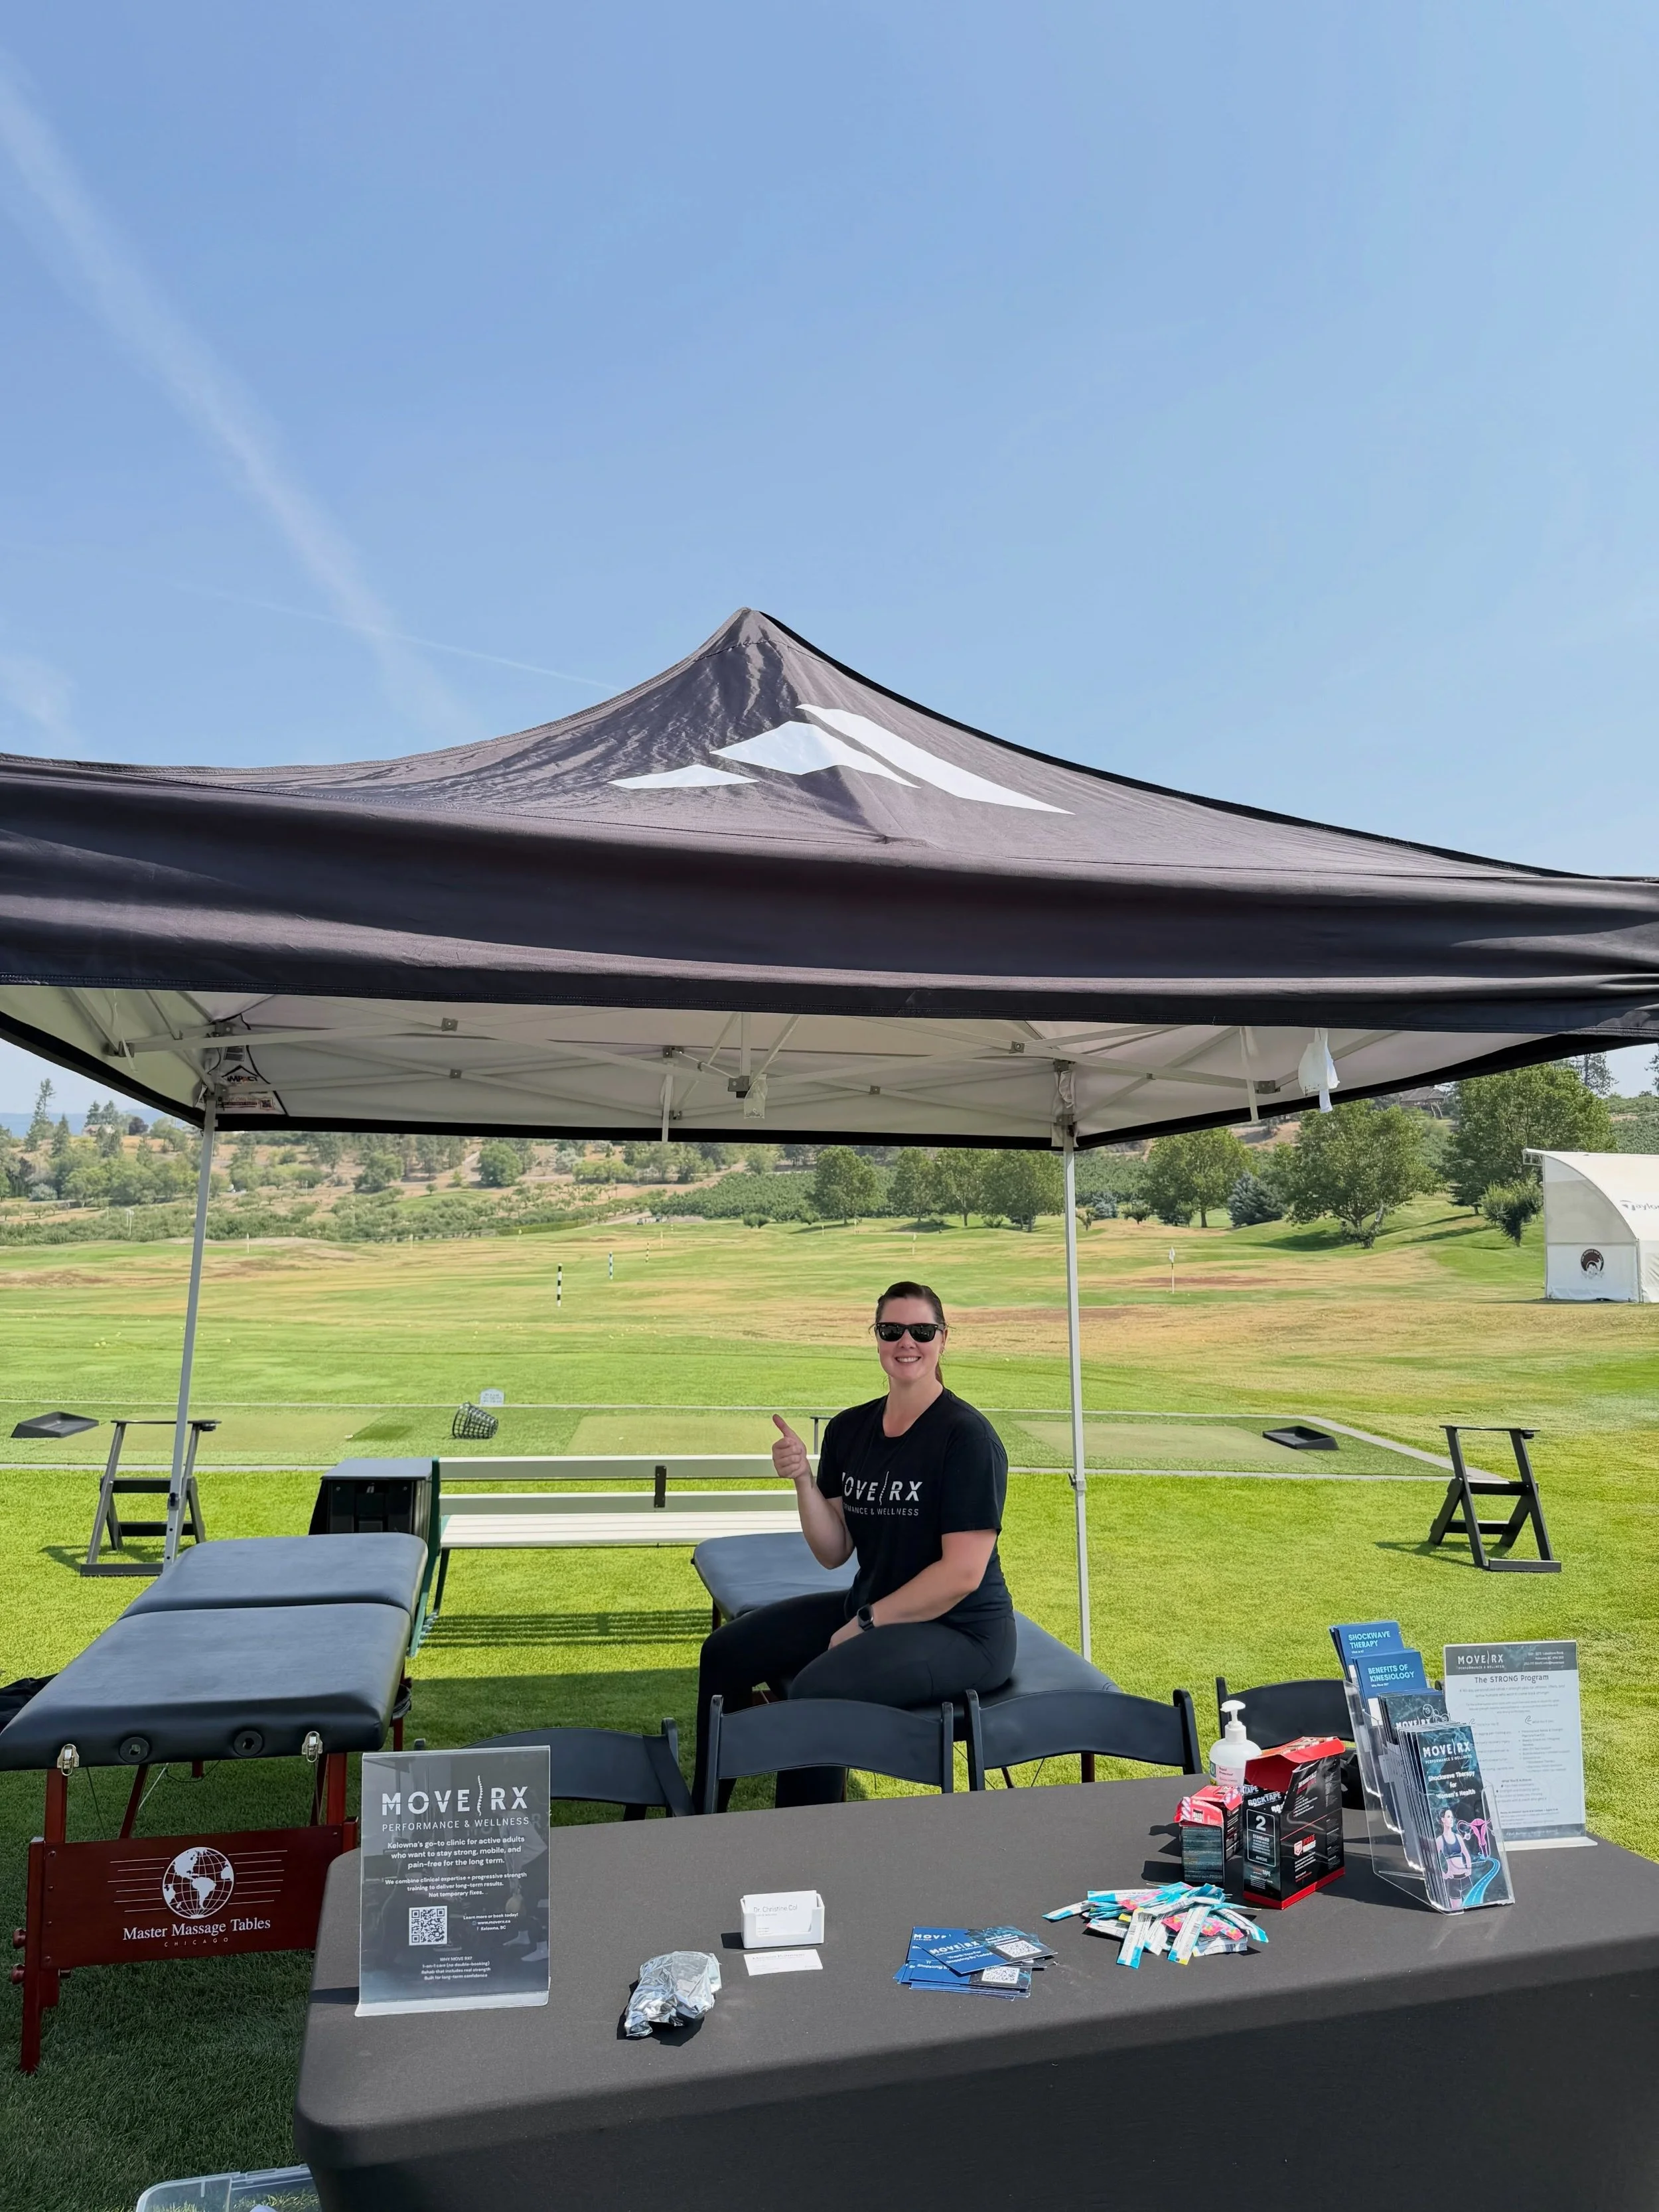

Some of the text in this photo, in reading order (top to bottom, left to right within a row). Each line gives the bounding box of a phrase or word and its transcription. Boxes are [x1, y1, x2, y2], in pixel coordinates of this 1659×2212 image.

[1620, 1200, 1659, 1211] Taylo
[841, 1472, 923, 1501] OVE RX
[1348, 1631, 1391, 1641] SHOCKWAVE
[1349, 1640, 1378, 1649] THERAPY
[1457, 1654, 1504, 1664] MOVE RX
[1368, 1665, 1398, 1674] BENEFITS
[1369, 1671, 1415, 1682] KINESIOLOGY
[1521, 1674, 1549, 1684] Program
[1422, 1741, 1471, 1758] MOVE RX
[1427, 1773, 1455, 1782] Shockwave
[1459, 1788, 1476, 1797] Health
[382, 1786, 528, 1816] MOVE RX
[1248, 1792, 1281, 1806] ROCKTAPE
[382, 1820, 460, 1832] PERFORMANCE
[474, 1817, 529, 1827] WELLNESS
[1256, 1815, 1266, 1832] 2
[407, 1861, 442, 1870] pain-free
[123, 1917, 271, 1941] Master Massage Tables
[164, 1937, 228, 1947] CHICAGO
[929, 1945, 962, 1954] MOVE
